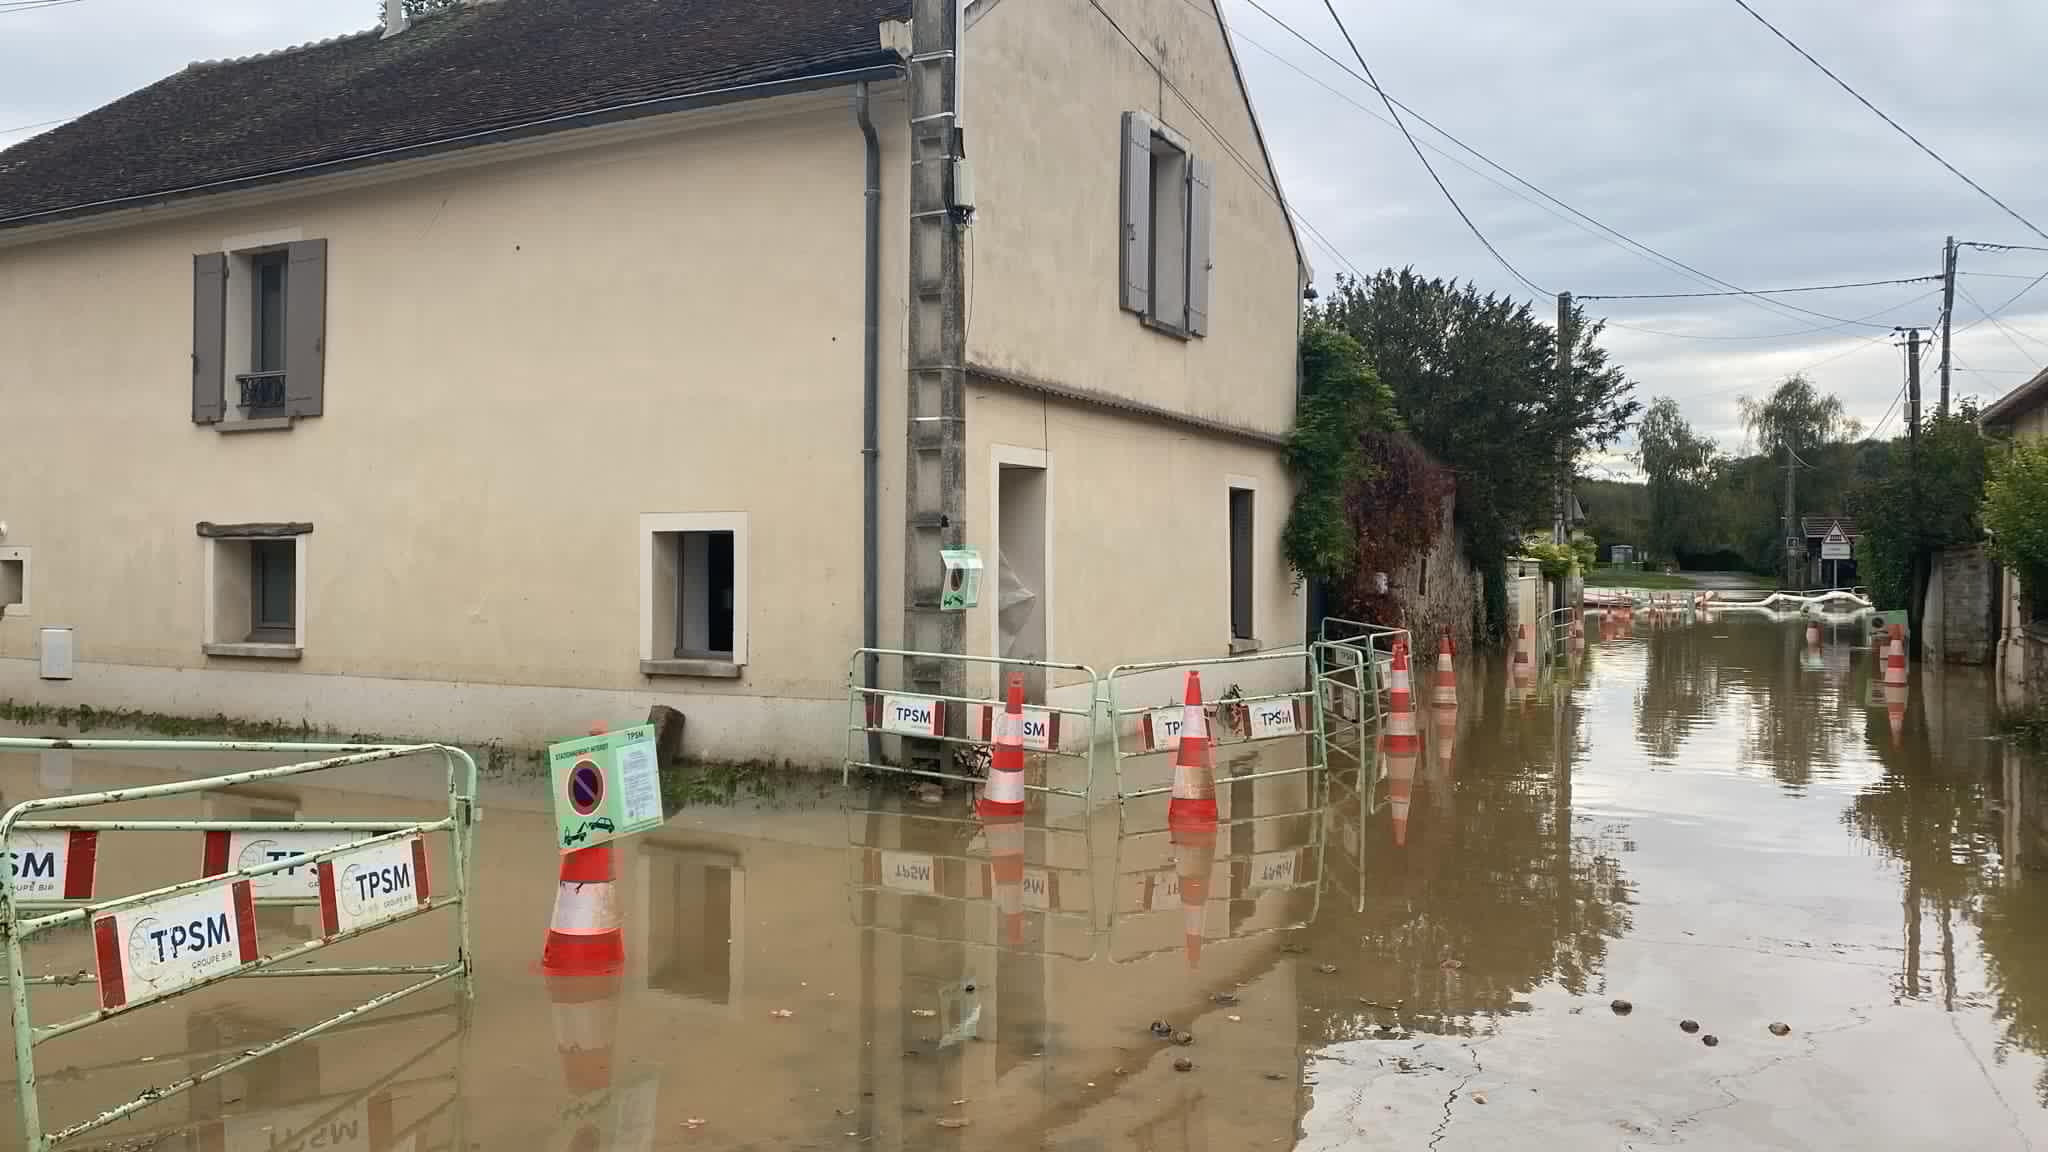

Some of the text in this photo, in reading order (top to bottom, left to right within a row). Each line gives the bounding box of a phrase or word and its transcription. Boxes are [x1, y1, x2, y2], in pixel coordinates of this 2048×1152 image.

[896, 707, 931, 724] TPSM
[1261, 710, 1292, 726] TPSM
[1024, 721, 1045, 737] SM
[1165, 720, 1183, 737] TP
[0, 852, 55, 878] SM
[355, 863, 411, 901] TPSM
[150, 912, 231, 963] TPSM
[191, 954, 220, 969] GROUPE
